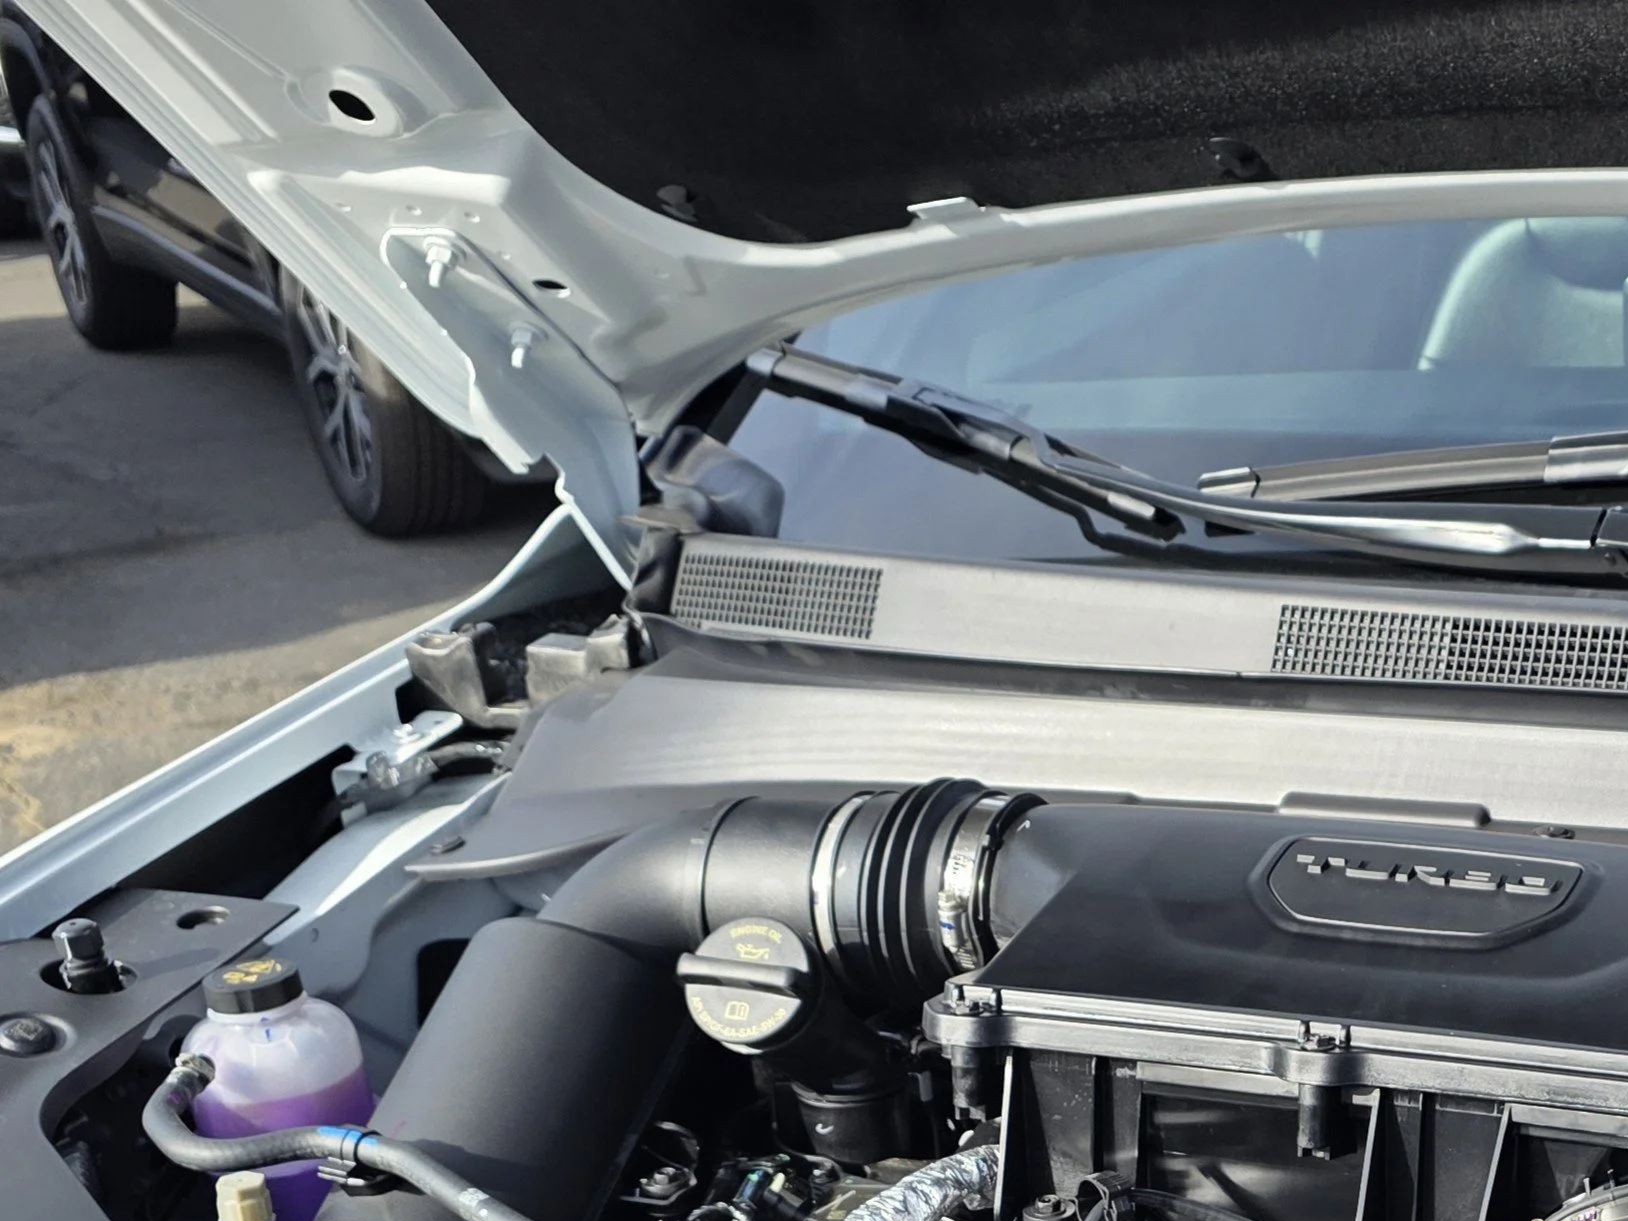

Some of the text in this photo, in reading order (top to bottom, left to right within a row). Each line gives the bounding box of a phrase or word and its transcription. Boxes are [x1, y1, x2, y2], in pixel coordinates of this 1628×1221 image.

[1296, 853, 1561, 897] TURBO
[730, 924, 783, 944] ENGINE OIL
